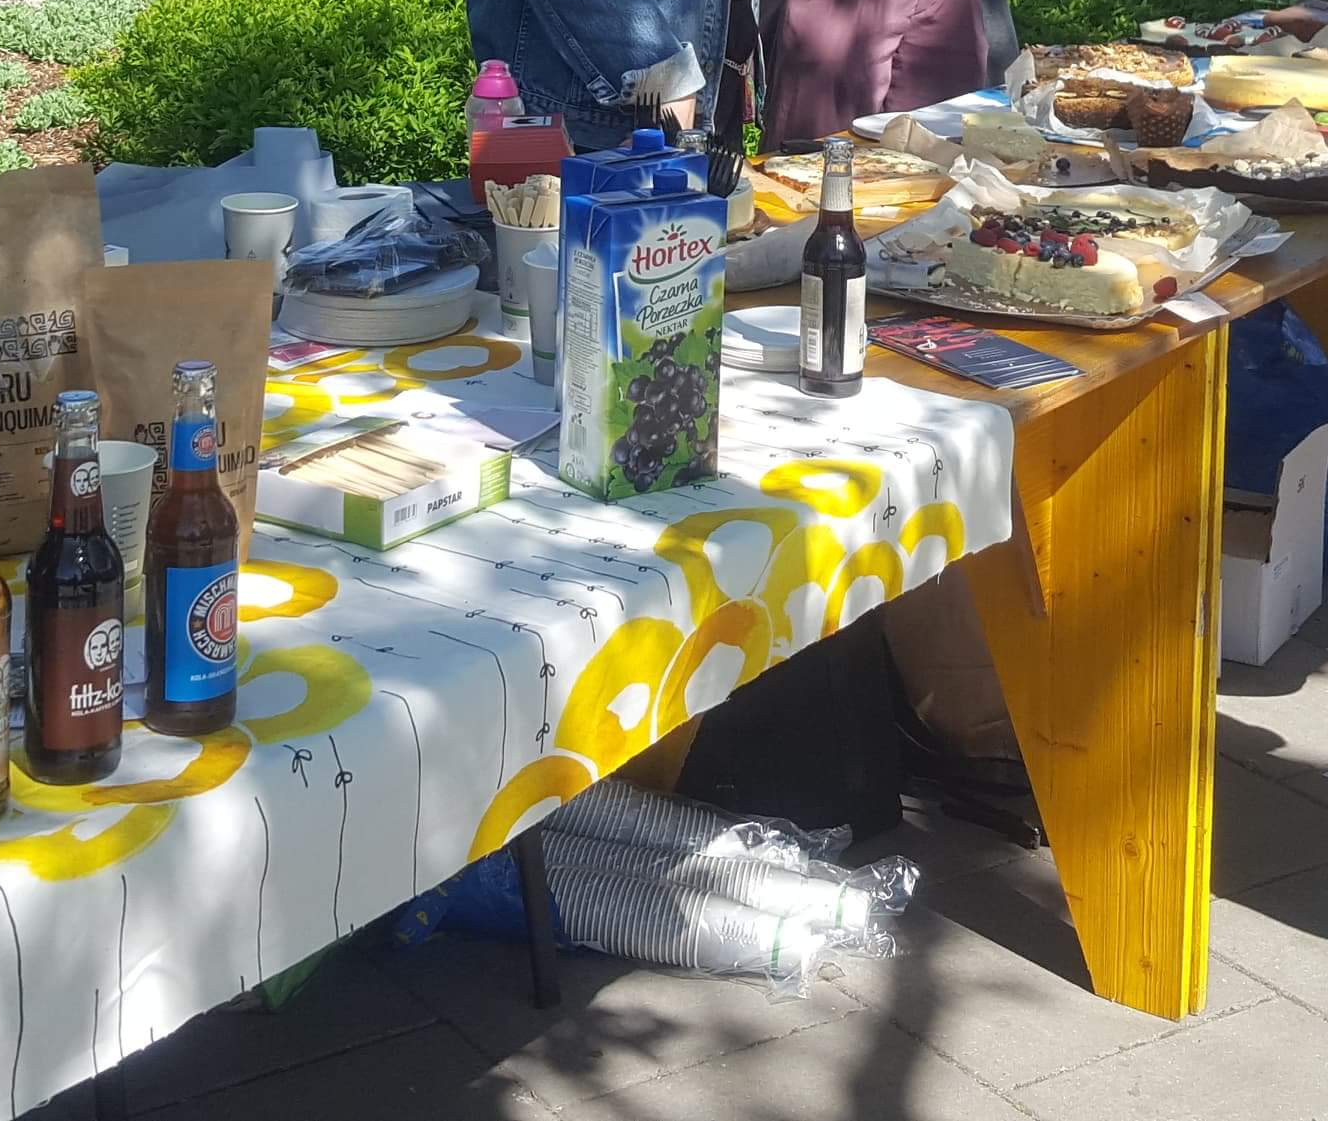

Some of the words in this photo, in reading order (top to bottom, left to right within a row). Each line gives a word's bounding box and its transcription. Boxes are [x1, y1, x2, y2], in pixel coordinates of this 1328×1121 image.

[632, 236, 713, 274] Hortex
[649, 278, 699, 305] Czarna
[636, 294, 704, 331] Porzeczka
[655, 319, 688, 337] NEKTAR
[427, 491, 463, 514] PAPSTAR
[70, 678, 123, 710] fritz-ko
